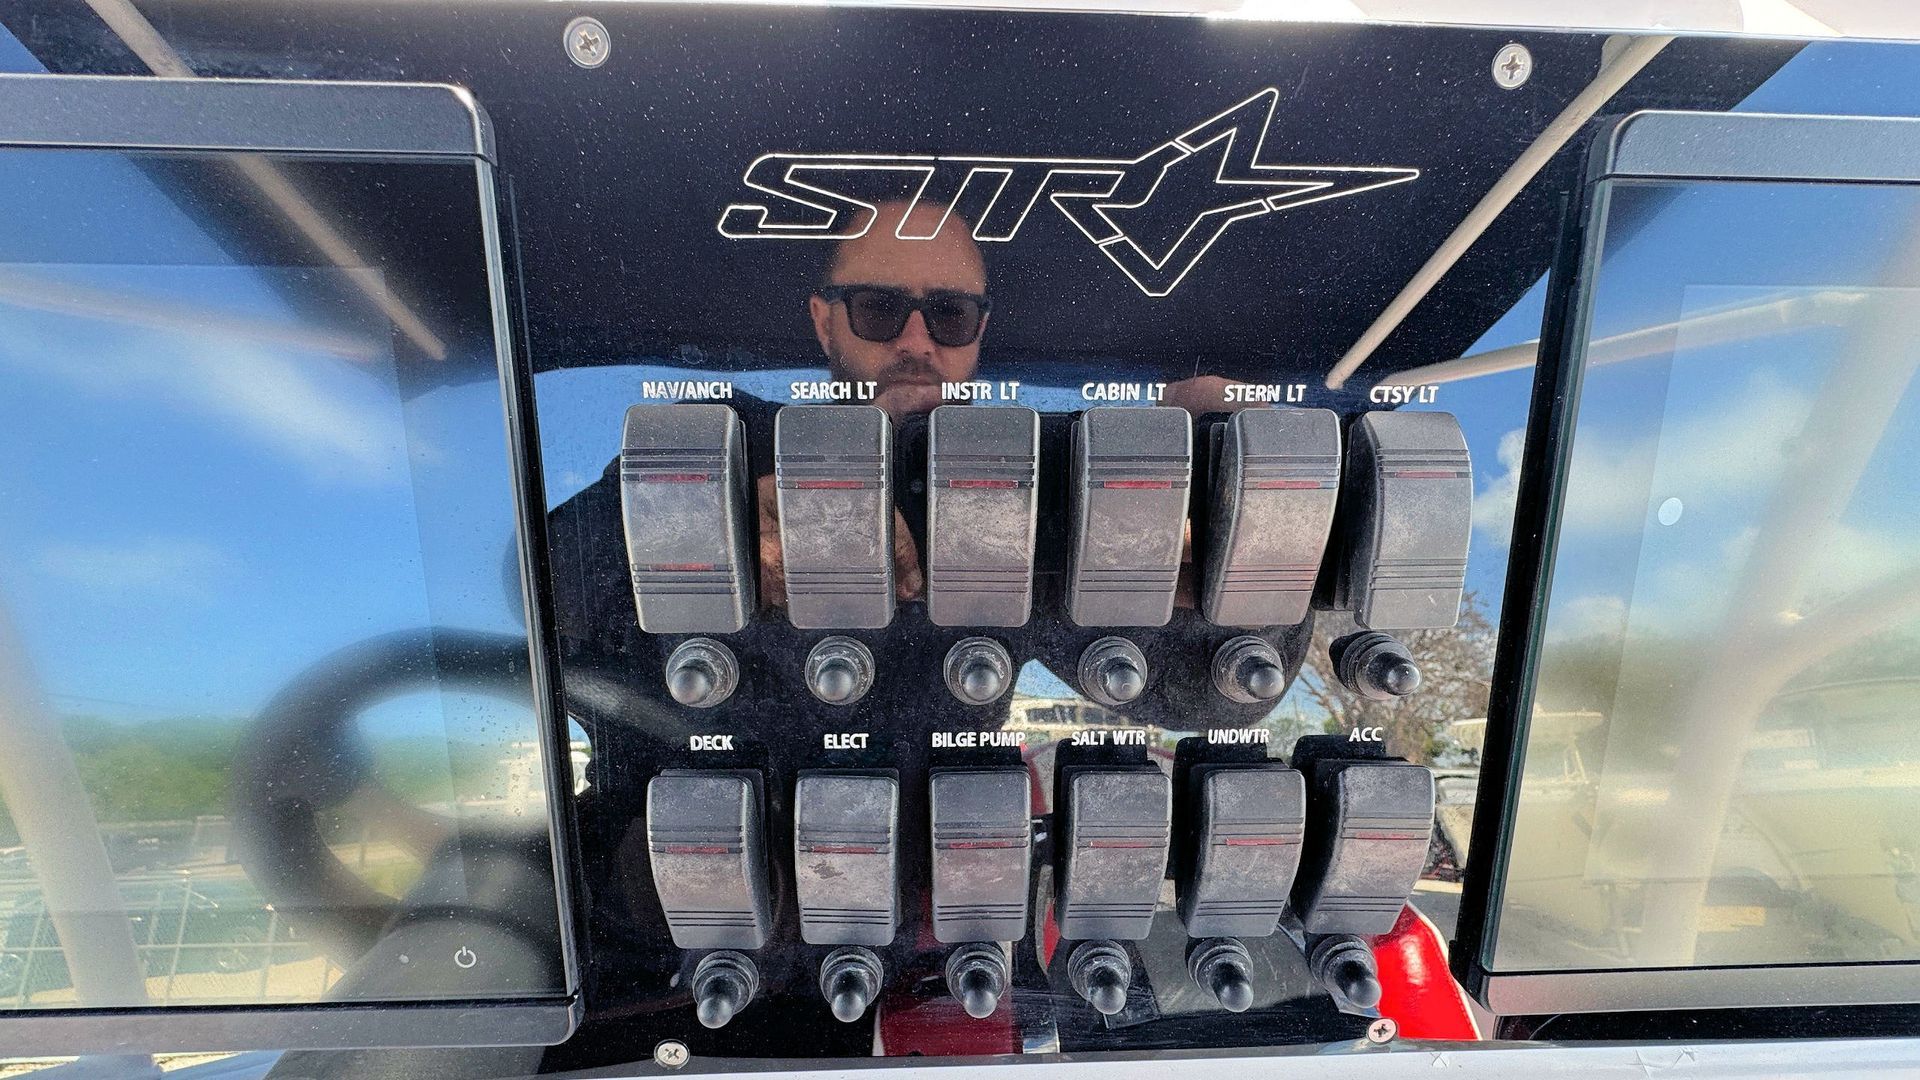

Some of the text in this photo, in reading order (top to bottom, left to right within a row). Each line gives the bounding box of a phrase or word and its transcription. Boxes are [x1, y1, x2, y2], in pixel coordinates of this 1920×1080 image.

[642, 381, 733, 399] NAV/ANCH
[790, 381, 878, 400] SEARCH LT
[941, 381, 1020, 400] INSTR LT
[1081, 382, 1167, 401] CABIN LT
[1223, 384, 1307, 403] STERN LT
[1369, 385, 1439, 403] CTSY LT
[690, 734, 734, 751] DECK
[823, 732, 869, 750] ELECT
[931, 731, 1026, 748] BILGE PUMP
[1071, 729, 1146, 746] SALT WTR
[1207, 728, 1270, 745] UNDWTR
[1348, 726, 1384, 743] ACC
